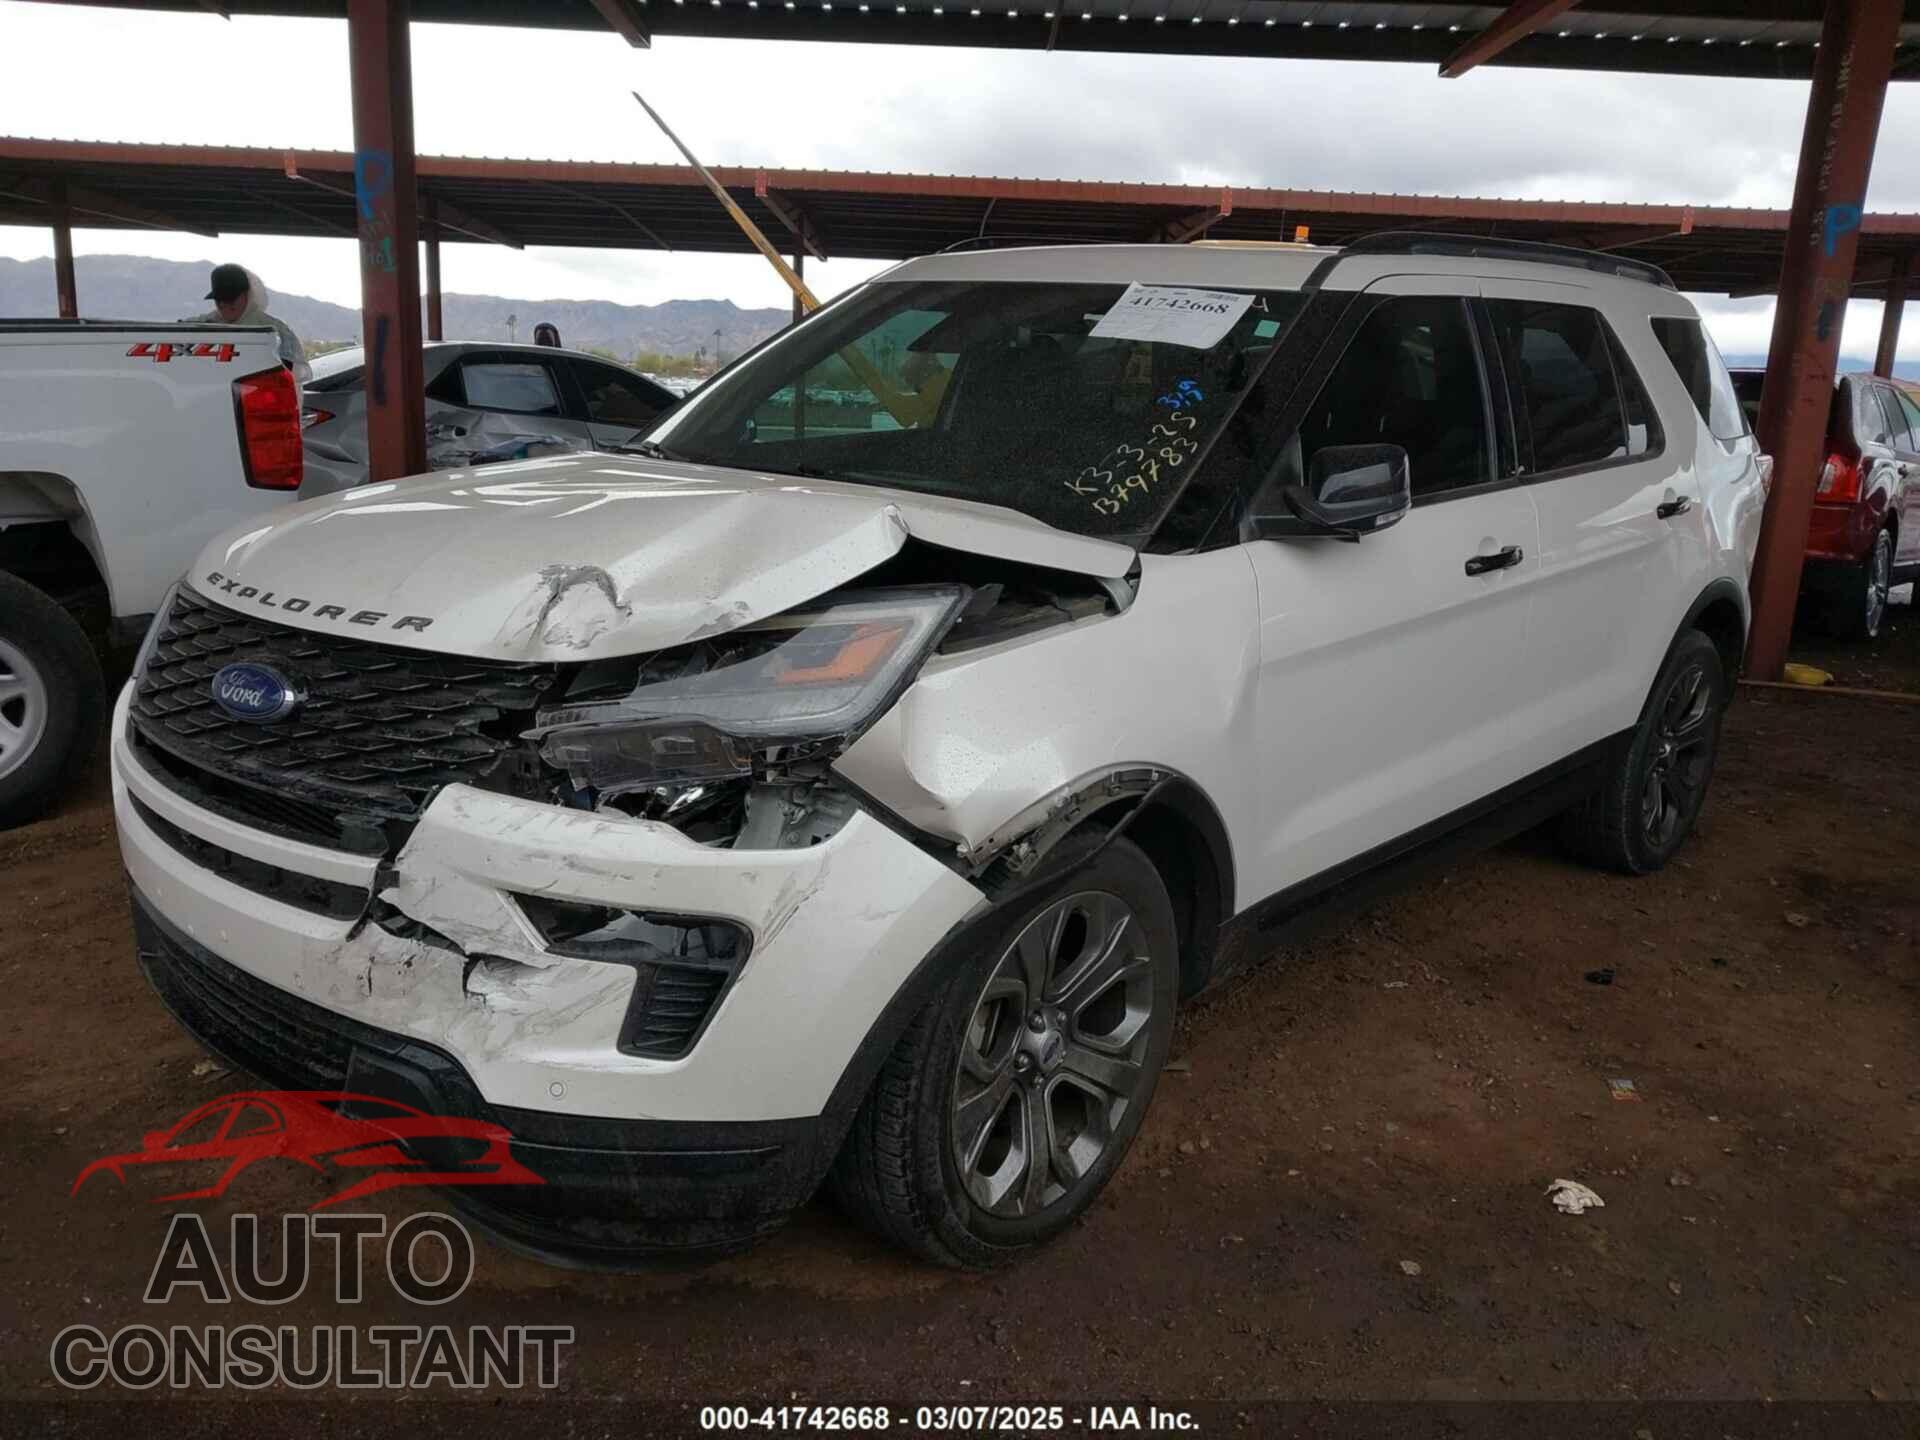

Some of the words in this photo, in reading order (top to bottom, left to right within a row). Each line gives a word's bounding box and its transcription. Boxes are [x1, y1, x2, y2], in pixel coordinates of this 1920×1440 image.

[1825, 203, 1862, 257] P
[1131, 296, 1230, 315] 41742668
[206, 571, 434, 632] EXPLORER
[220, 670, 267, 708] Ford
